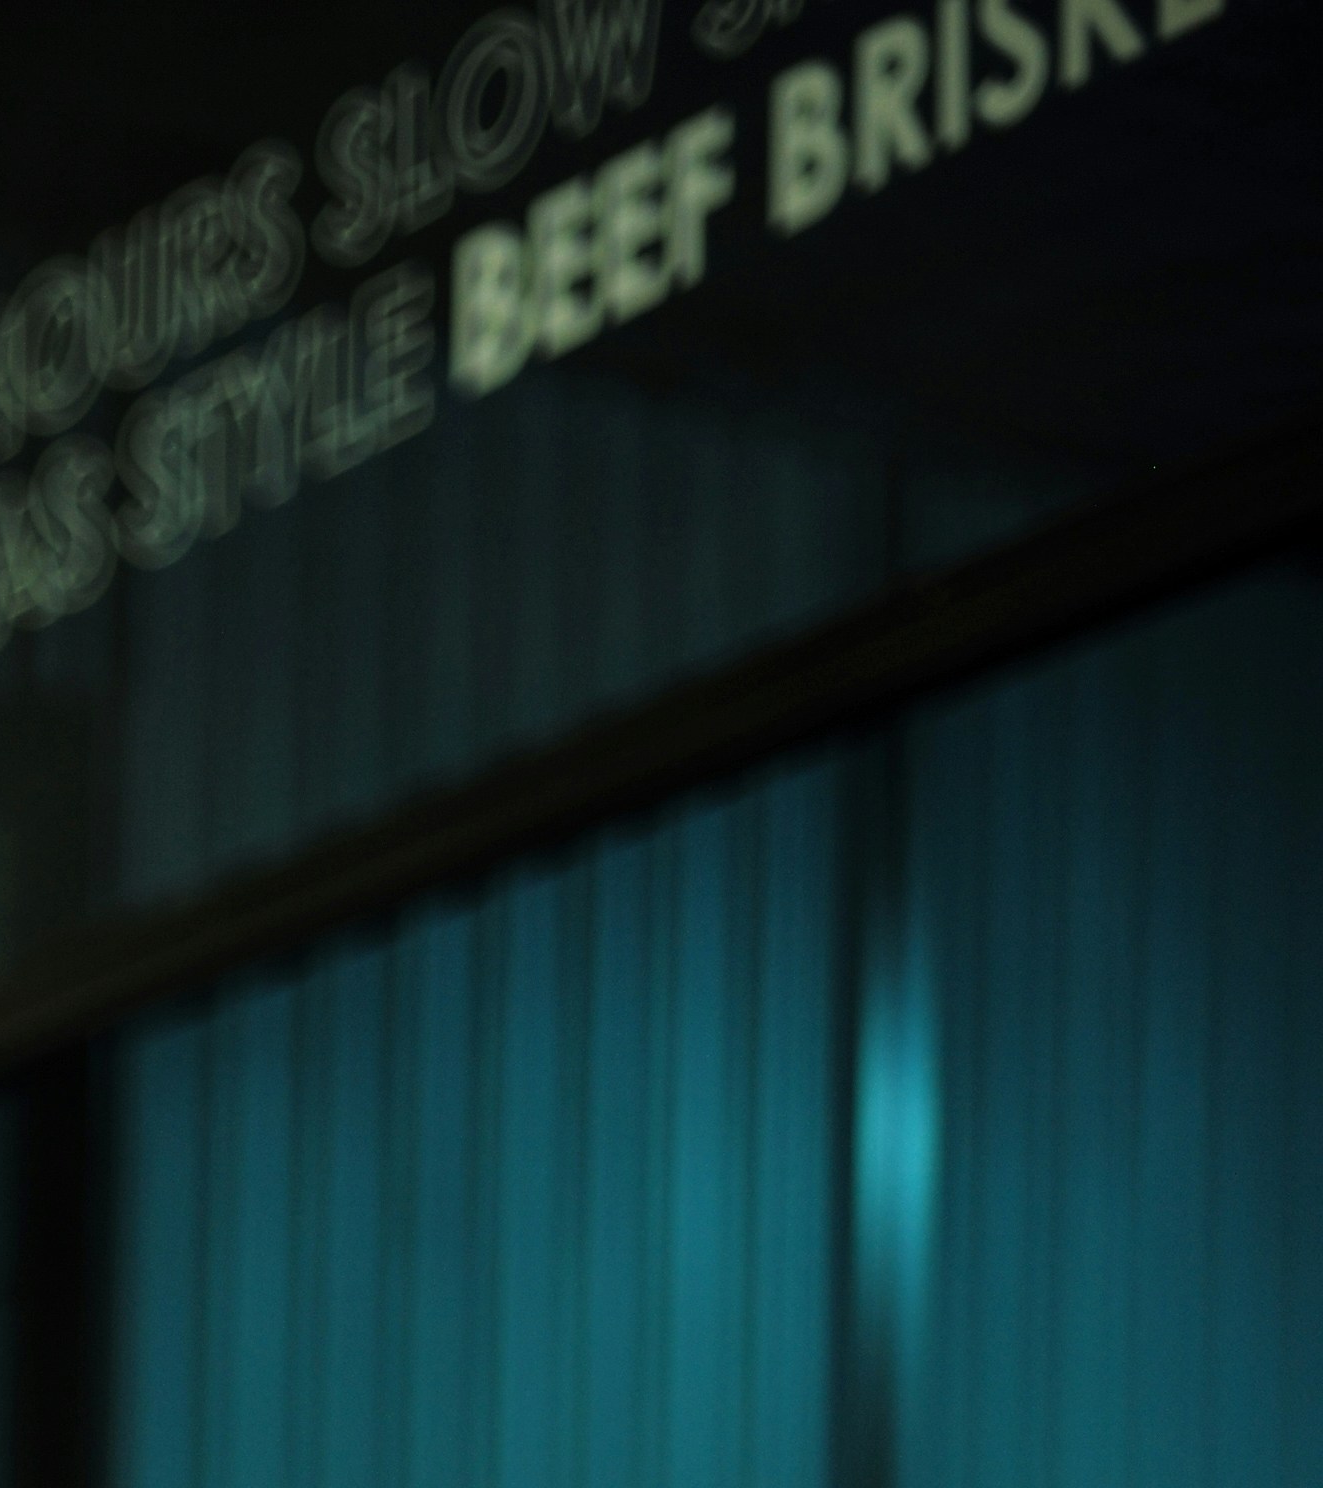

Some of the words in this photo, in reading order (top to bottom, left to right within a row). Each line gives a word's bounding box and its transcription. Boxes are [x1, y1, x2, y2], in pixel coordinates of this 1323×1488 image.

[312, 0, 659, 267] SLOW
[113, 258, 437, 570] STYLE
[447, 103, 737, 400] BEEF
